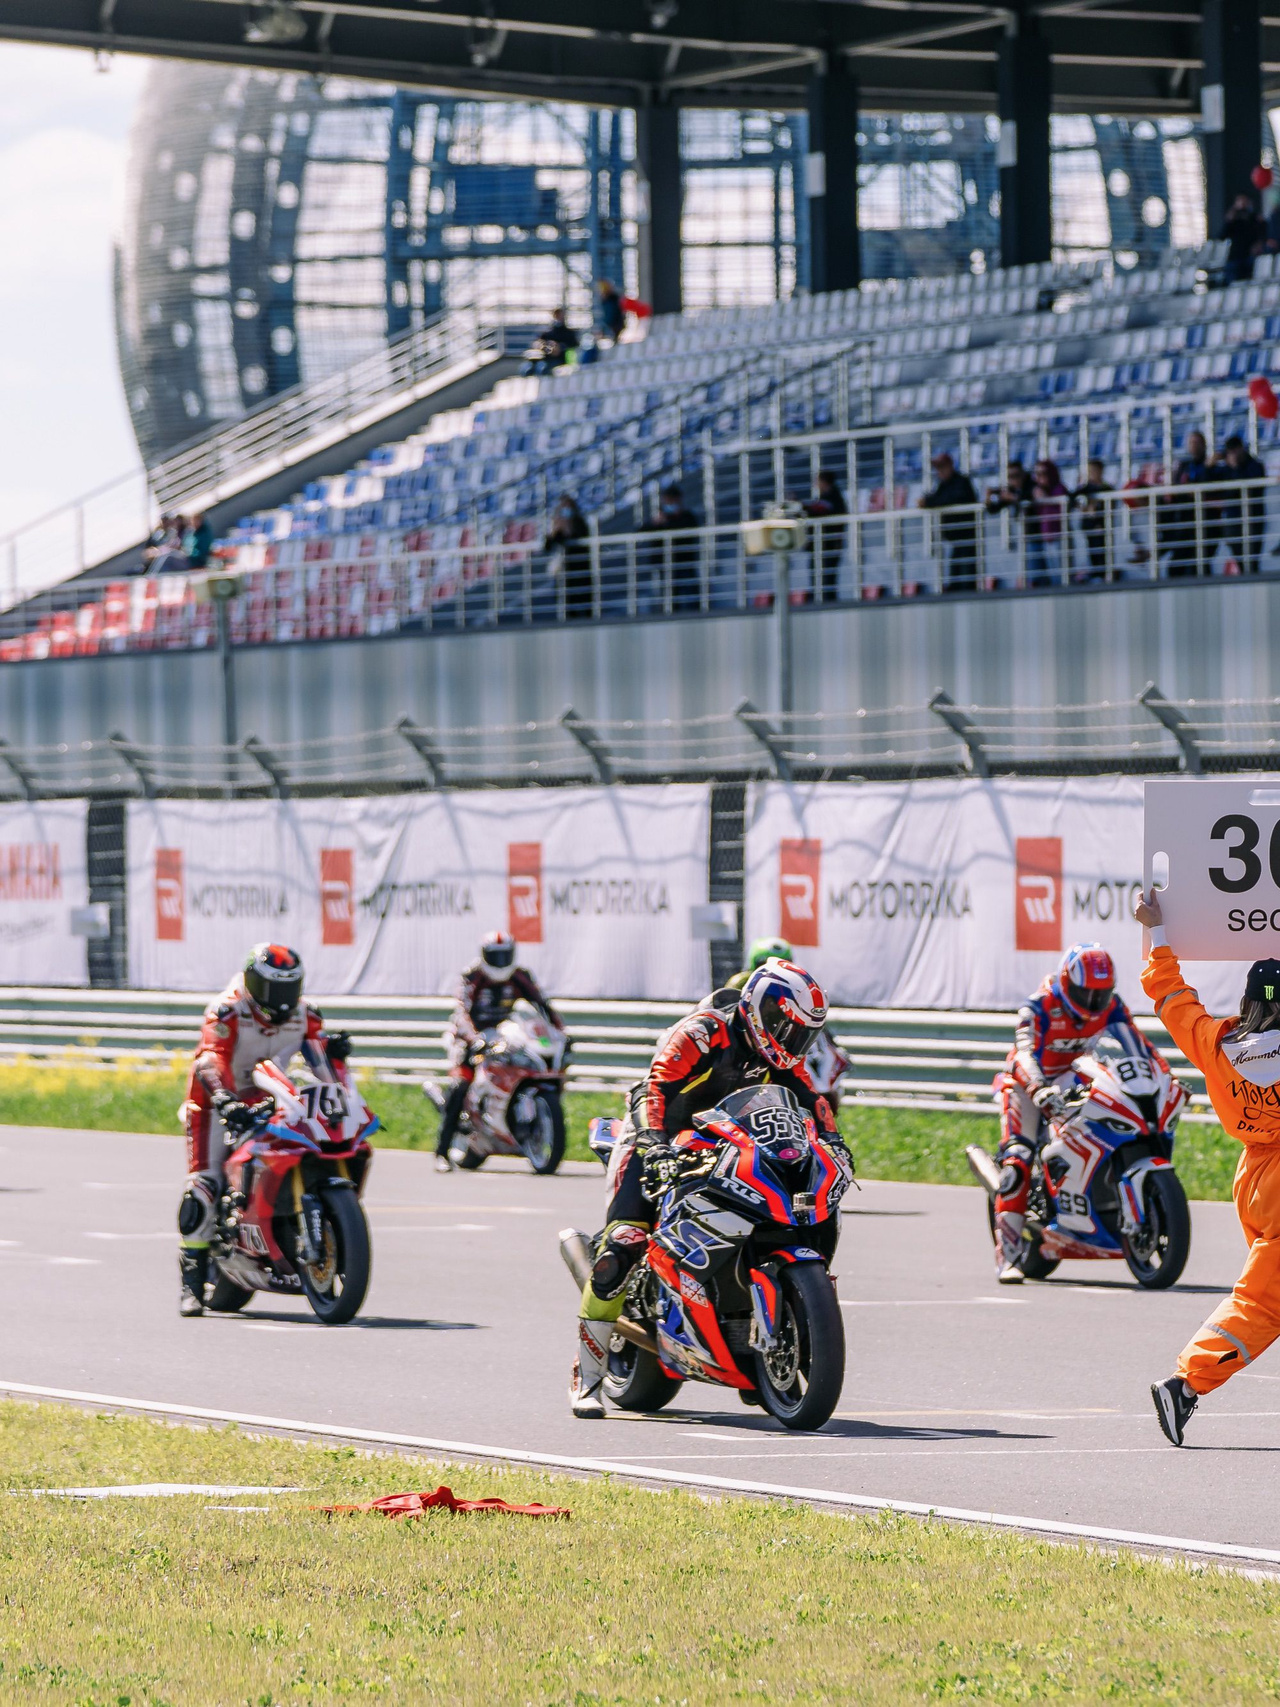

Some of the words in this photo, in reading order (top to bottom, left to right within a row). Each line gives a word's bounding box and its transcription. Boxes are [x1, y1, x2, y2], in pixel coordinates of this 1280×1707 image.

[549, 880, 671, 915] MOTORRIKA
[828, 880, 972, 919] MOTORRIKA
[750, 1105, 809, 1147] 555
